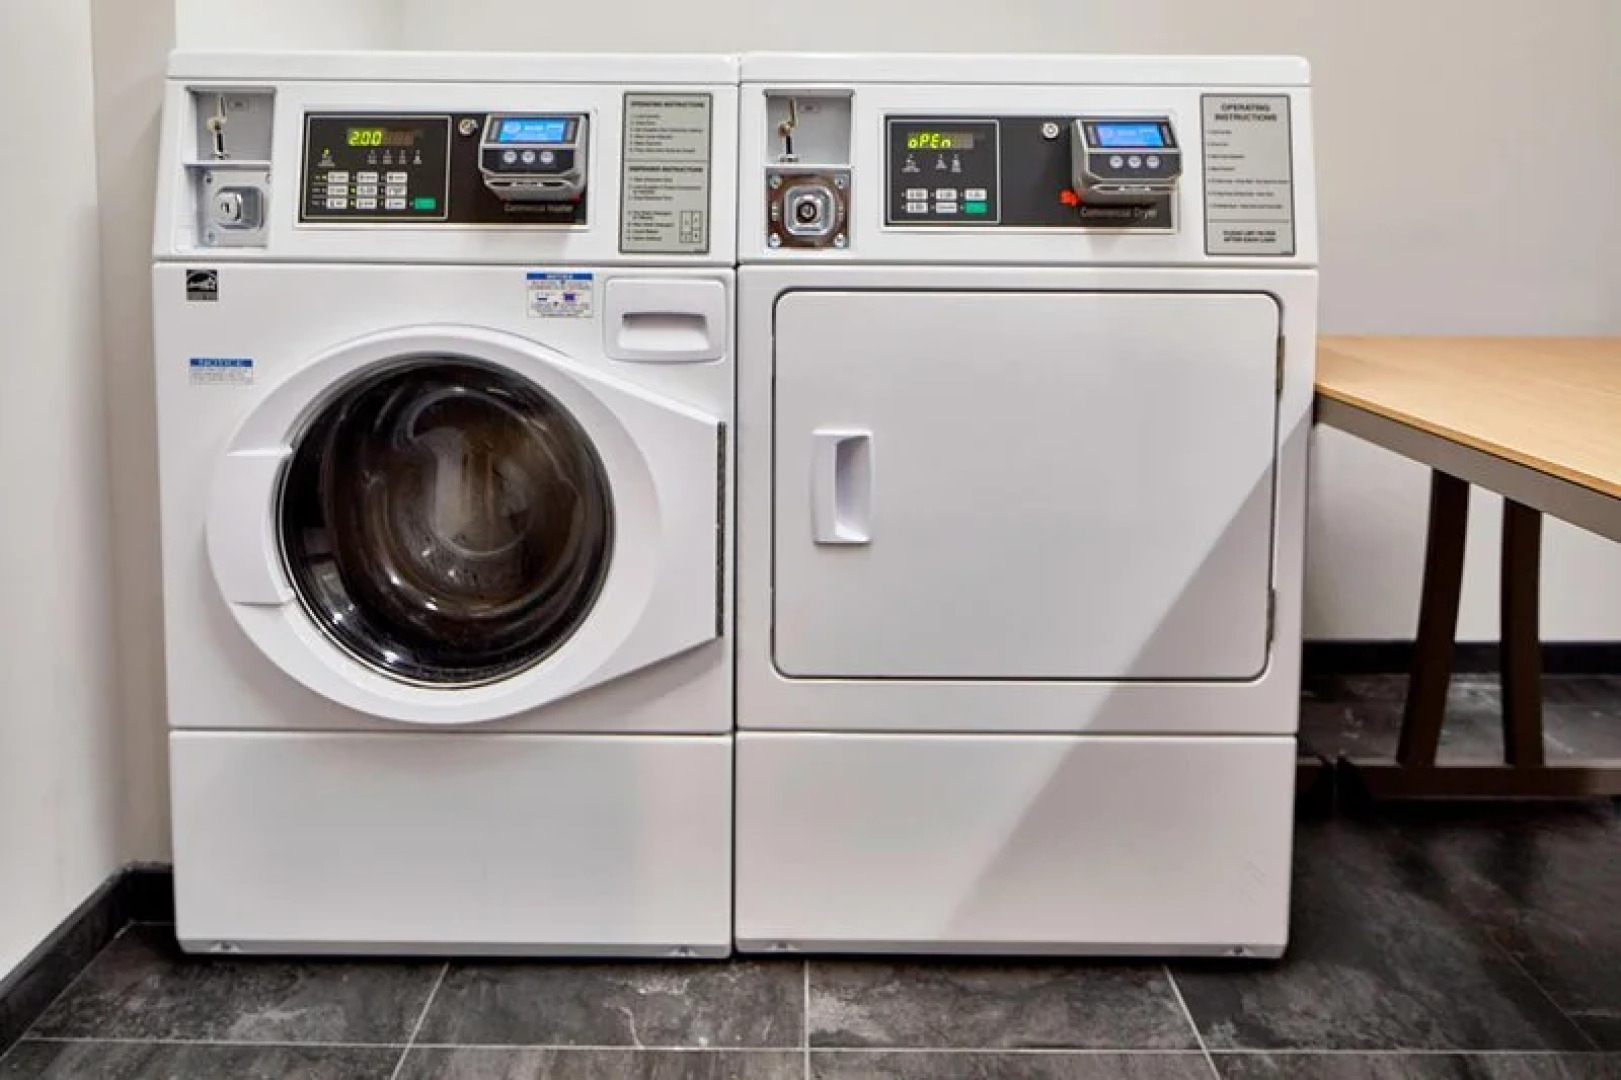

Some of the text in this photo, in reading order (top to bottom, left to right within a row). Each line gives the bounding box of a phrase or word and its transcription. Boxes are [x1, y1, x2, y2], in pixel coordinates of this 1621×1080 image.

[1220, 103, 1271, 112] OPERATING
[1214, 112, 1277, 121] INSTRUCTIONS
[1134, 206, 1157, 219] Dryer
